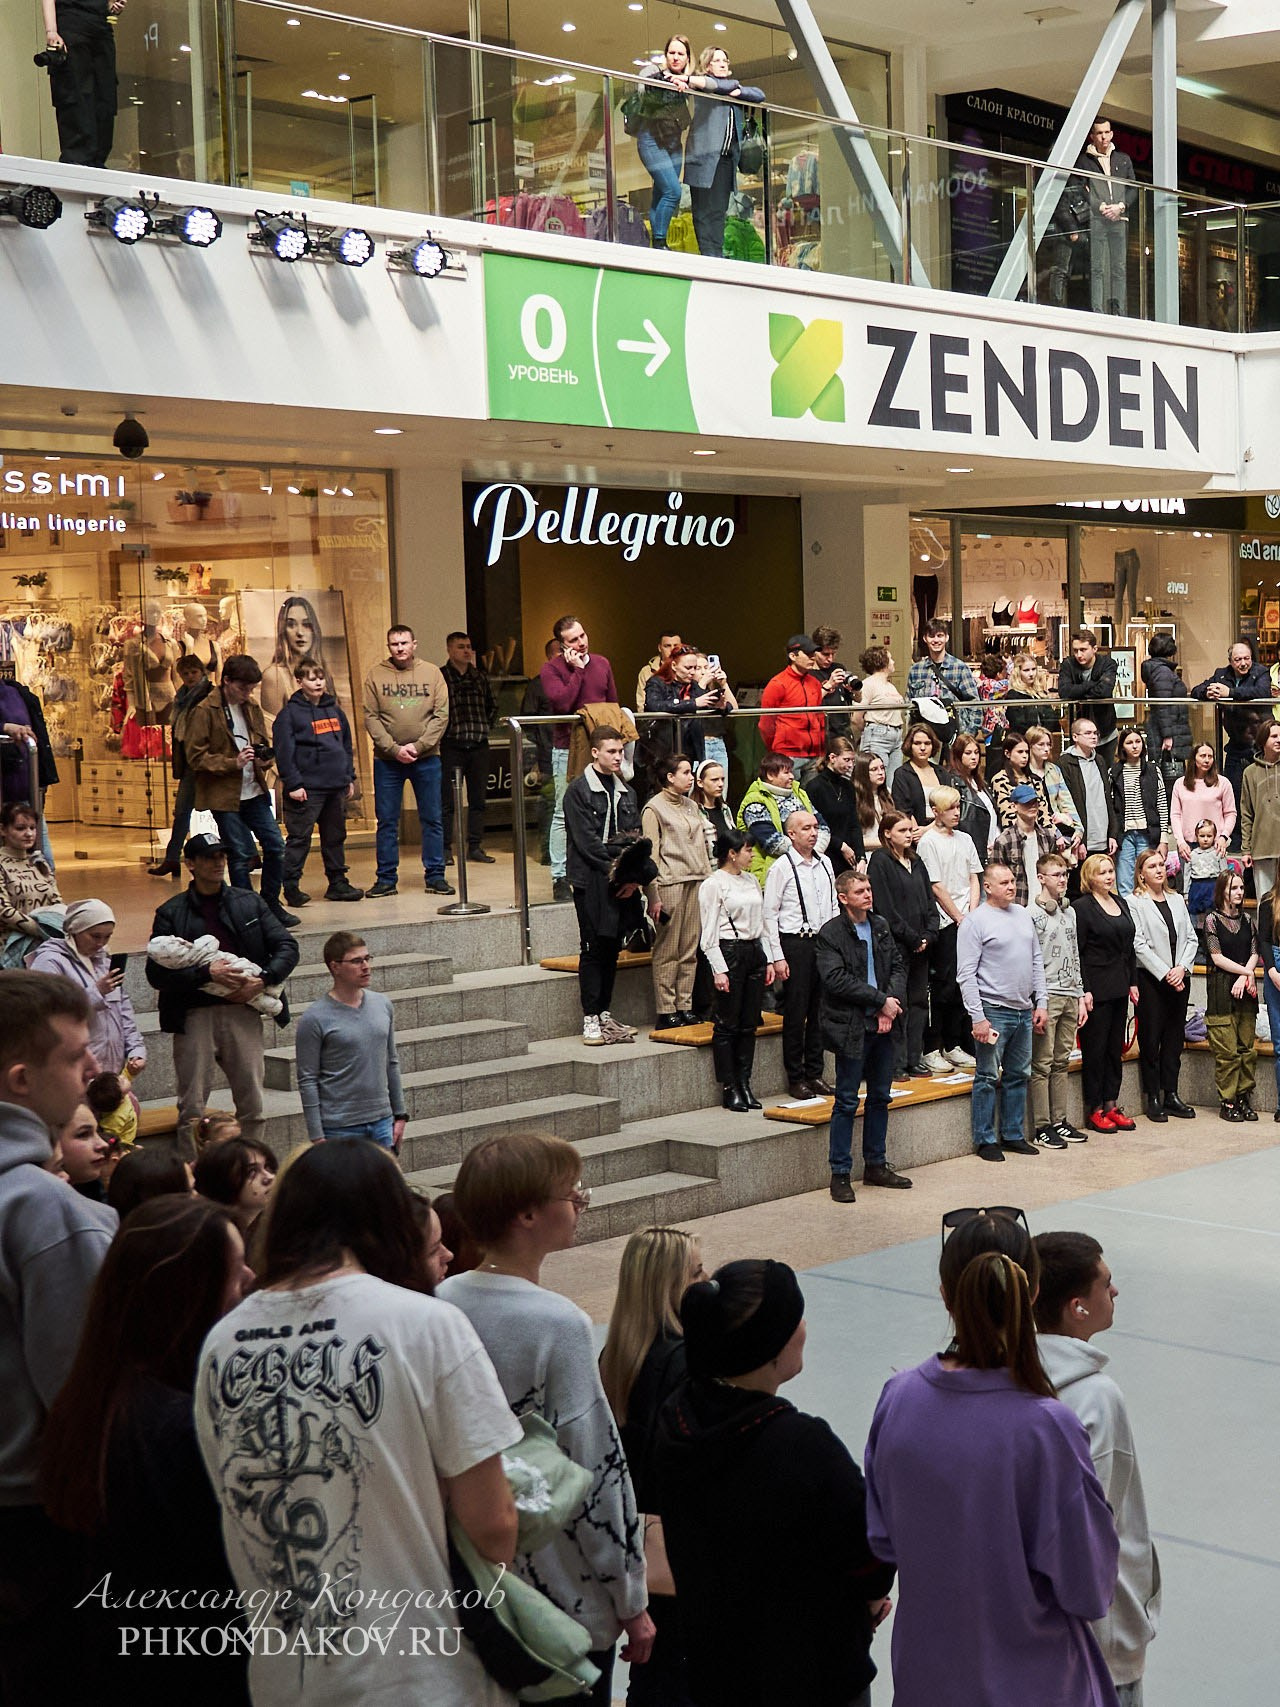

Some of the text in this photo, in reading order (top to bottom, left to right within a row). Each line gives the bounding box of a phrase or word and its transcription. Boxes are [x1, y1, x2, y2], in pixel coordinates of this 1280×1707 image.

[966, 94, 1055, 131] САЛОН КРАСОТЫ
[519, 294, 567, 364] 0
[508, 363, 579, 386] УРОВЕНЬ
[867, 325, 1200, 454] ZENDEN
[48, 513, 127, 535] lingerie
[473, 483, 735, 566] Pellegrino
[382, 683, 430, 697] HUSTLE
[234, 1318, 338, 1342] GIRLS ARE
[207, 1335, 388, 1430] EBELS
